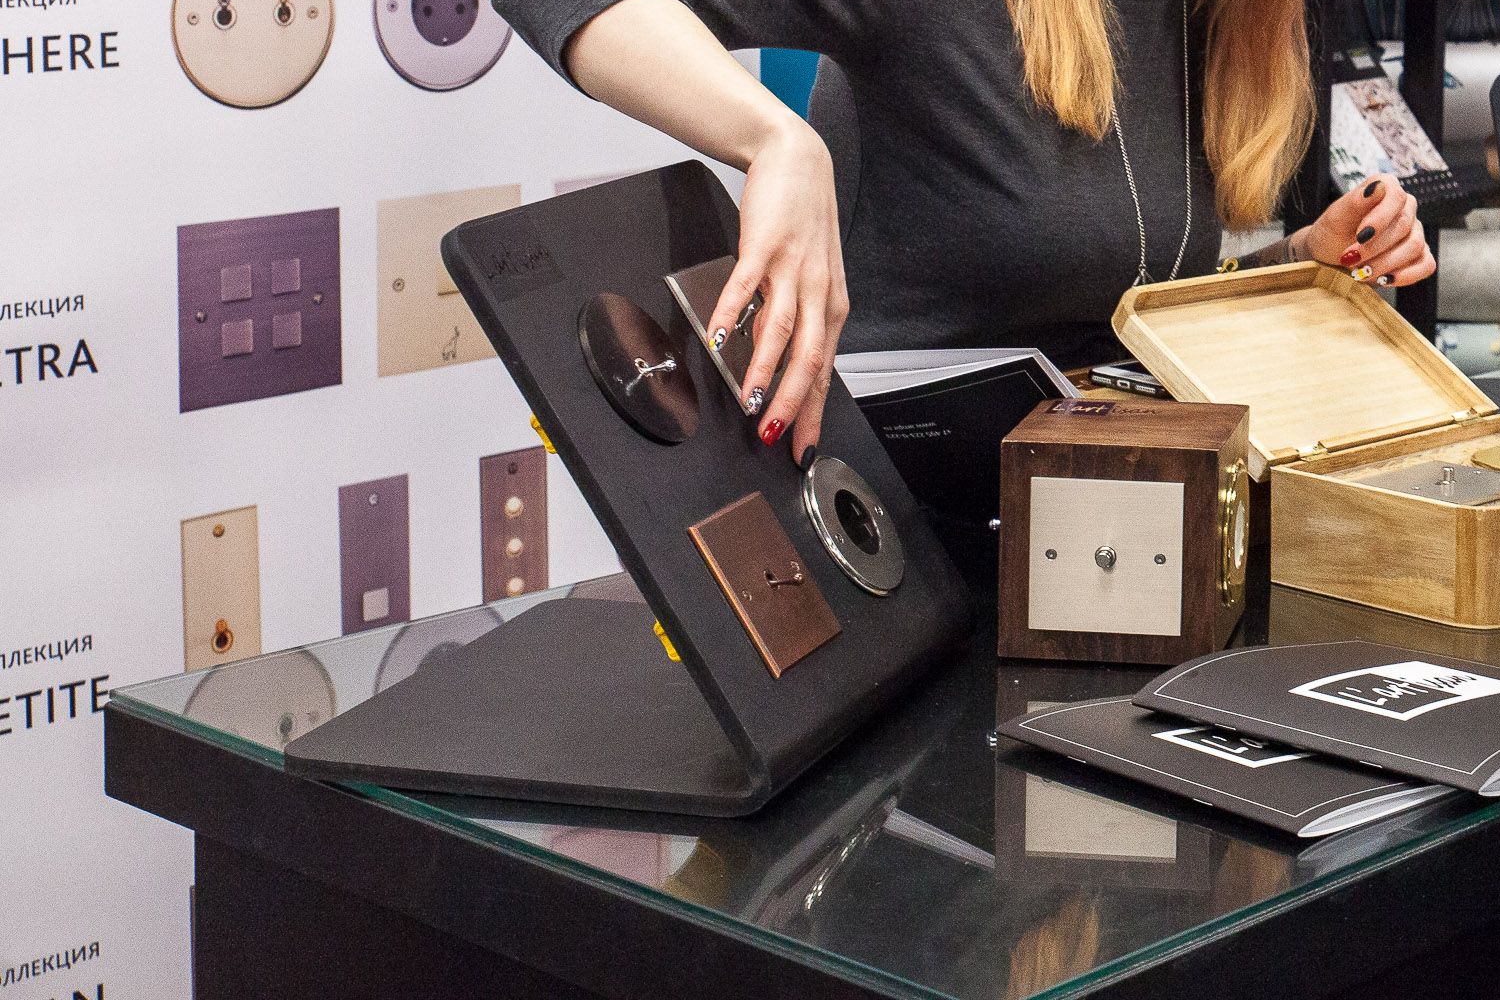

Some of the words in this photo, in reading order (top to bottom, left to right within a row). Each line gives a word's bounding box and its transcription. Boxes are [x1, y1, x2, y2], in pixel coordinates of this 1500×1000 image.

[3, 32, 120, 75] HERE
[0, 295, 85, 321] ЛЕКЦИЯ
[0, 339, 99, 388] TRA
[0, 674, 110, 736] ETITE
[1337, 675, 1478, 706] L'artisan
[0, 941, 100, 987] ЛЛЕКЦИЯ
